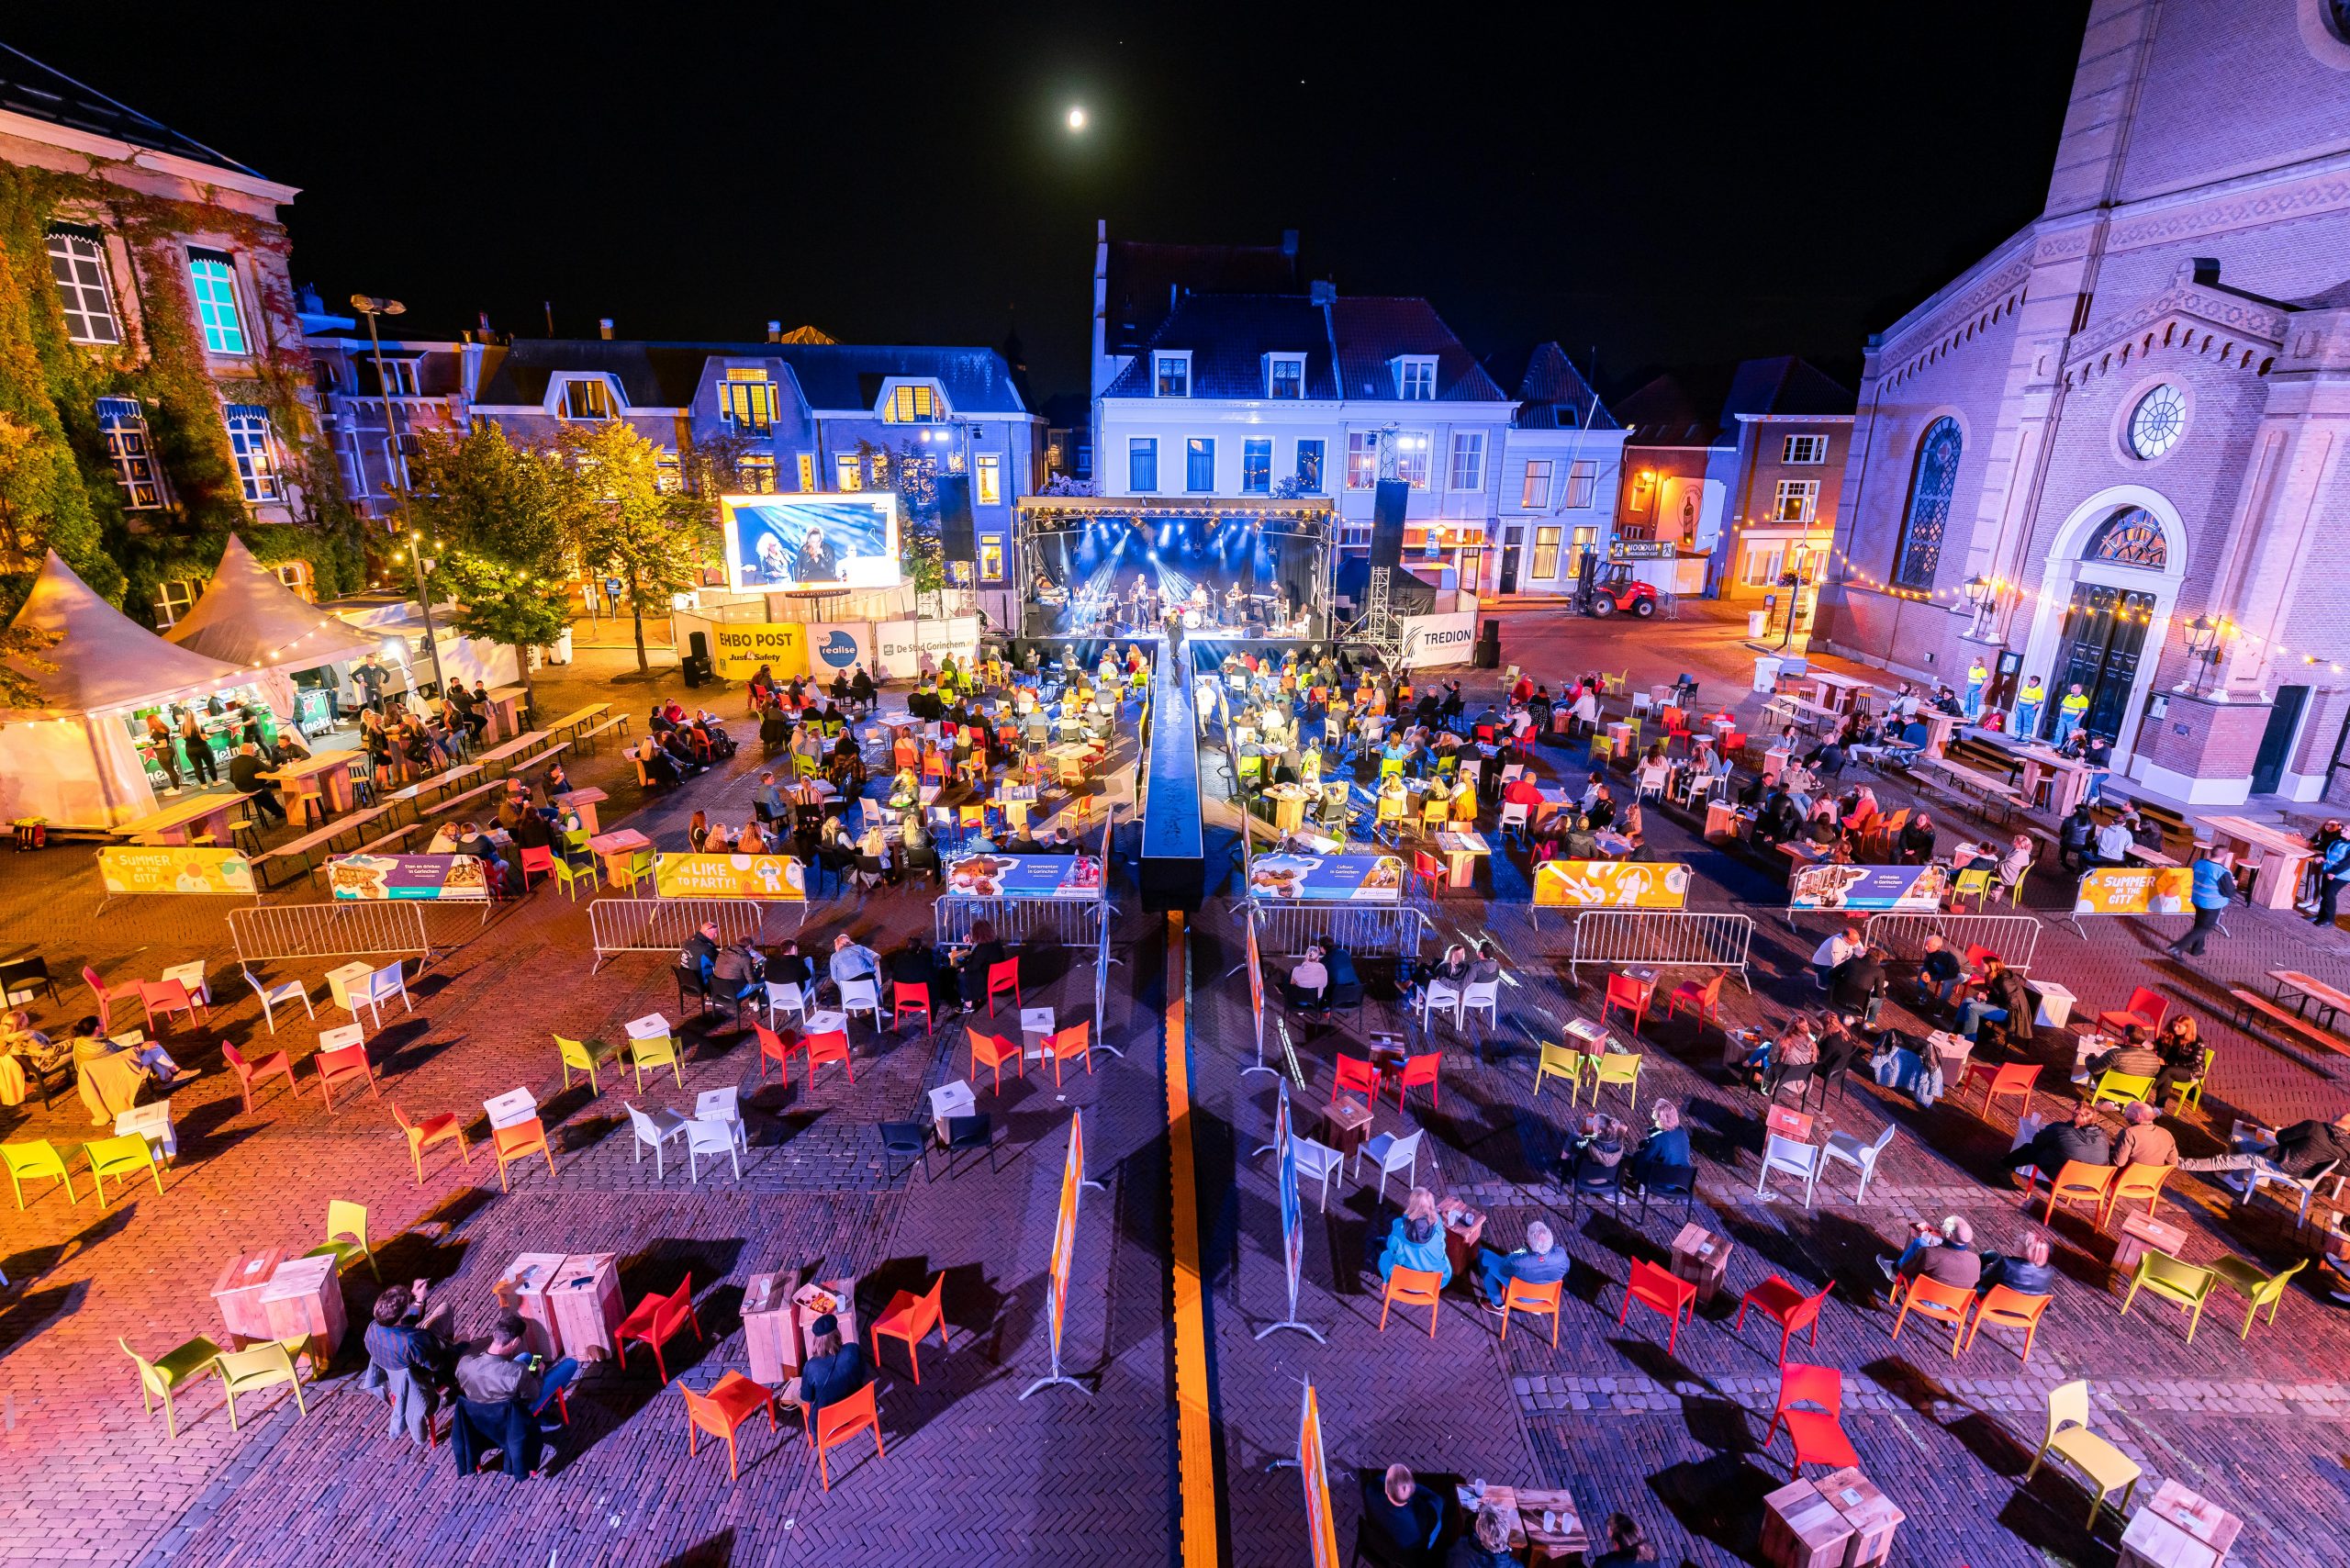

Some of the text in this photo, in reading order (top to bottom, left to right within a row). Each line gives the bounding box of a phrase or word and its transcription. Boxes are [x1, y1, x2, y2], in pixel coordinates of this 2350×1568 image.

[719, 633, 793, 647] EHBO POST
[1424, 629, 1472, 645] TREDION
[822, 645, 856, 655] realise
[897, 644, 907, 654] De
[909, 642, 925, 653] Stad
[118, 855, 172, 867] SUMMER
[691, 862, 727, 877] LIKE
[133, 873, 158, 883] CITY
[677, 877, 736, 889] TO PARTY!
[2103, 876, 2156, 888] SUMMER
[2108, 894, 2134, 904] CITY
